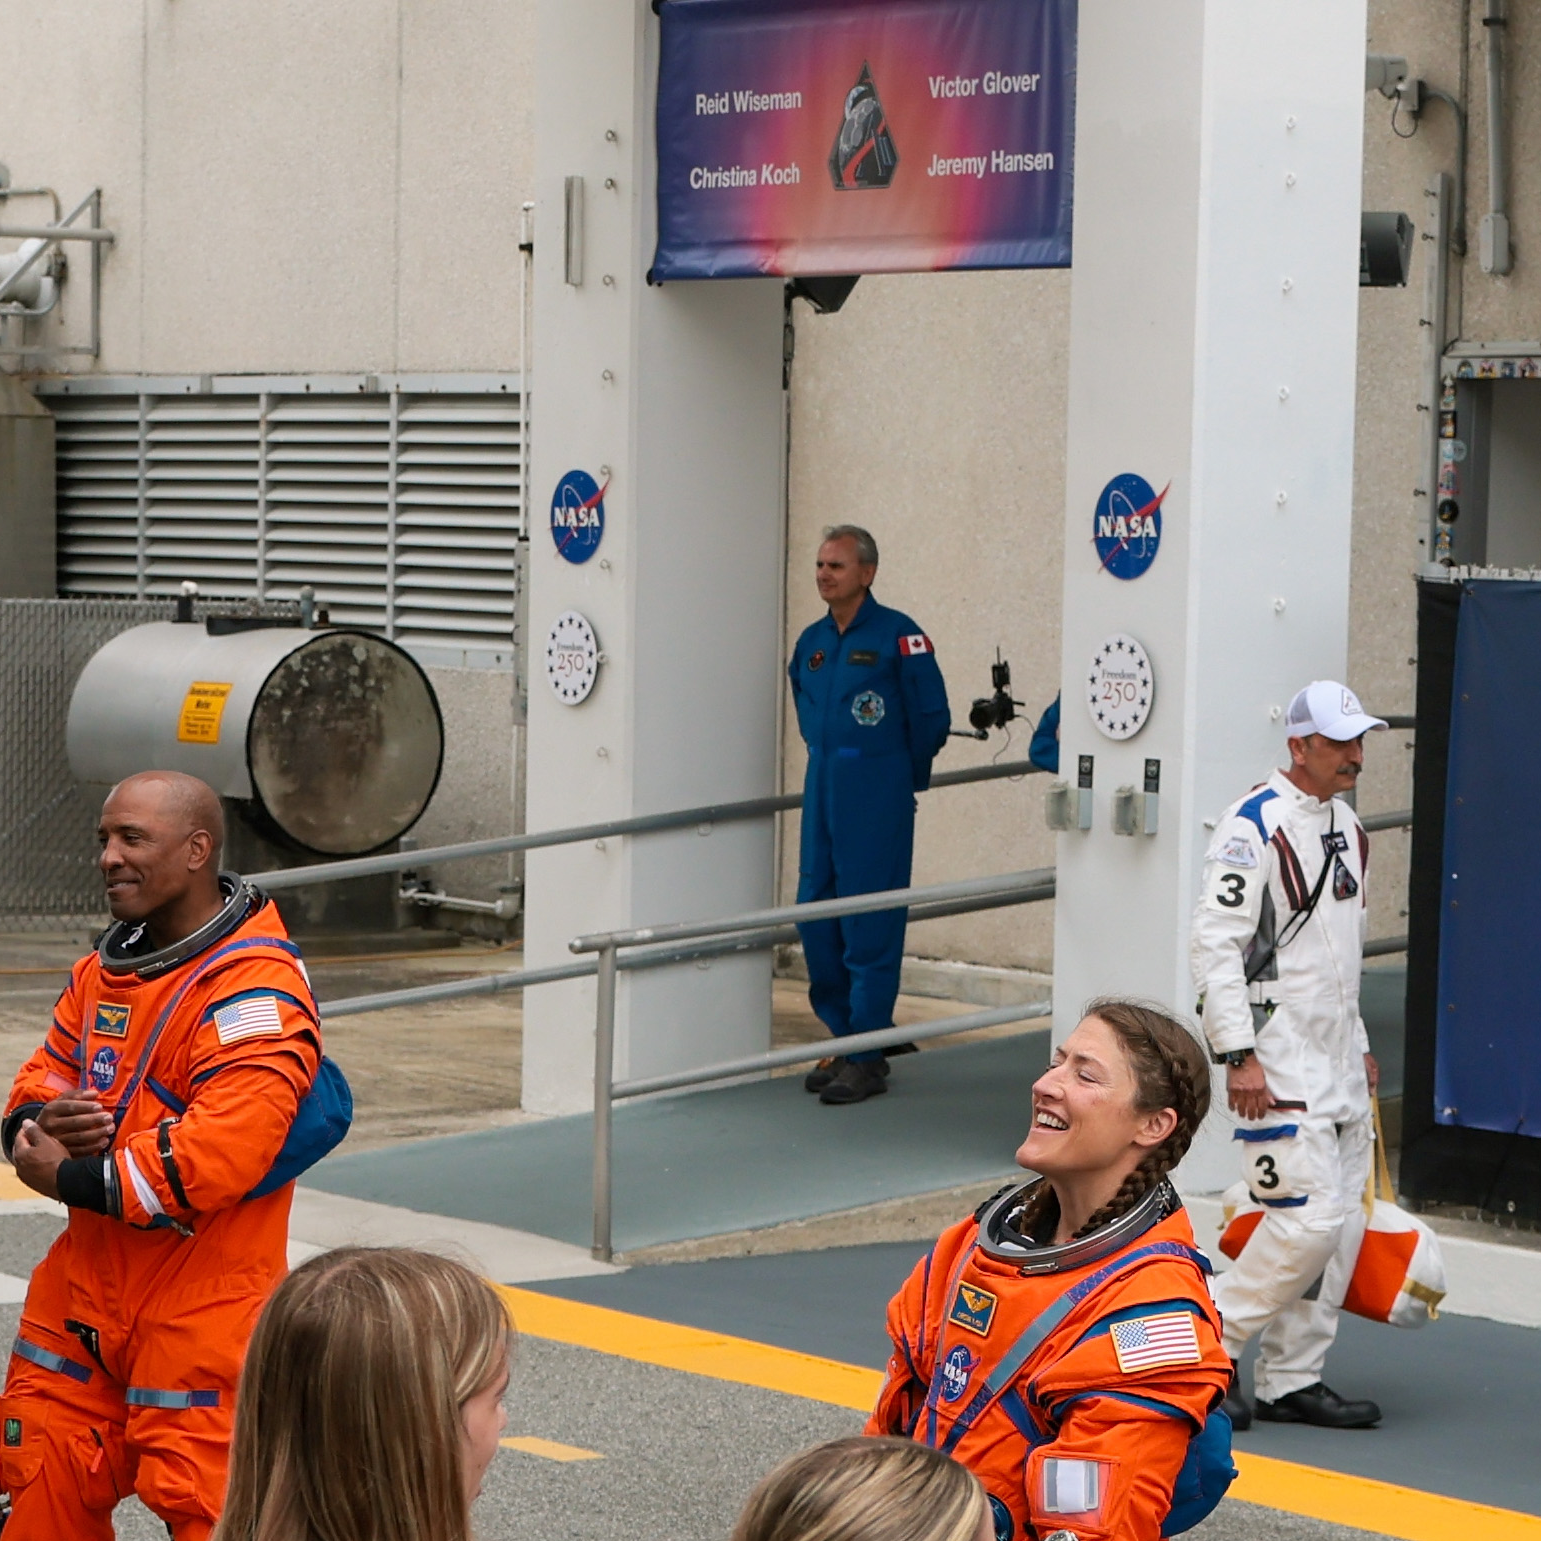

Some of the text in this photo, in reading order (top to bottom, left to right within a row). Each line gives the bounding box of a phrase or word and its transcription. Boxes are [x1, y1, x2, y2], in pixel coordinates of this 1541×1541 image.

[928, 71, 1040, 99] Victor Glover
[695, 90, 802, 116] Reid Wiseman
[689, 162, 801, 190] Christina Koch
[927, 150, 1054, 179] Jeremy Hansen
[553, 507, 600, 528] NASA
[1098, 515, 1158, 538] NASA
[557, 653, 585, 679] 250
[1101, 669, 1137, 680] Freedom
[1102, 681, 1137, 709] 250
[1216, 872, 1246, 908] 3
[1253, 1153, 1279, 1190] 3
[943, 1362, 968, 1387] NASA
